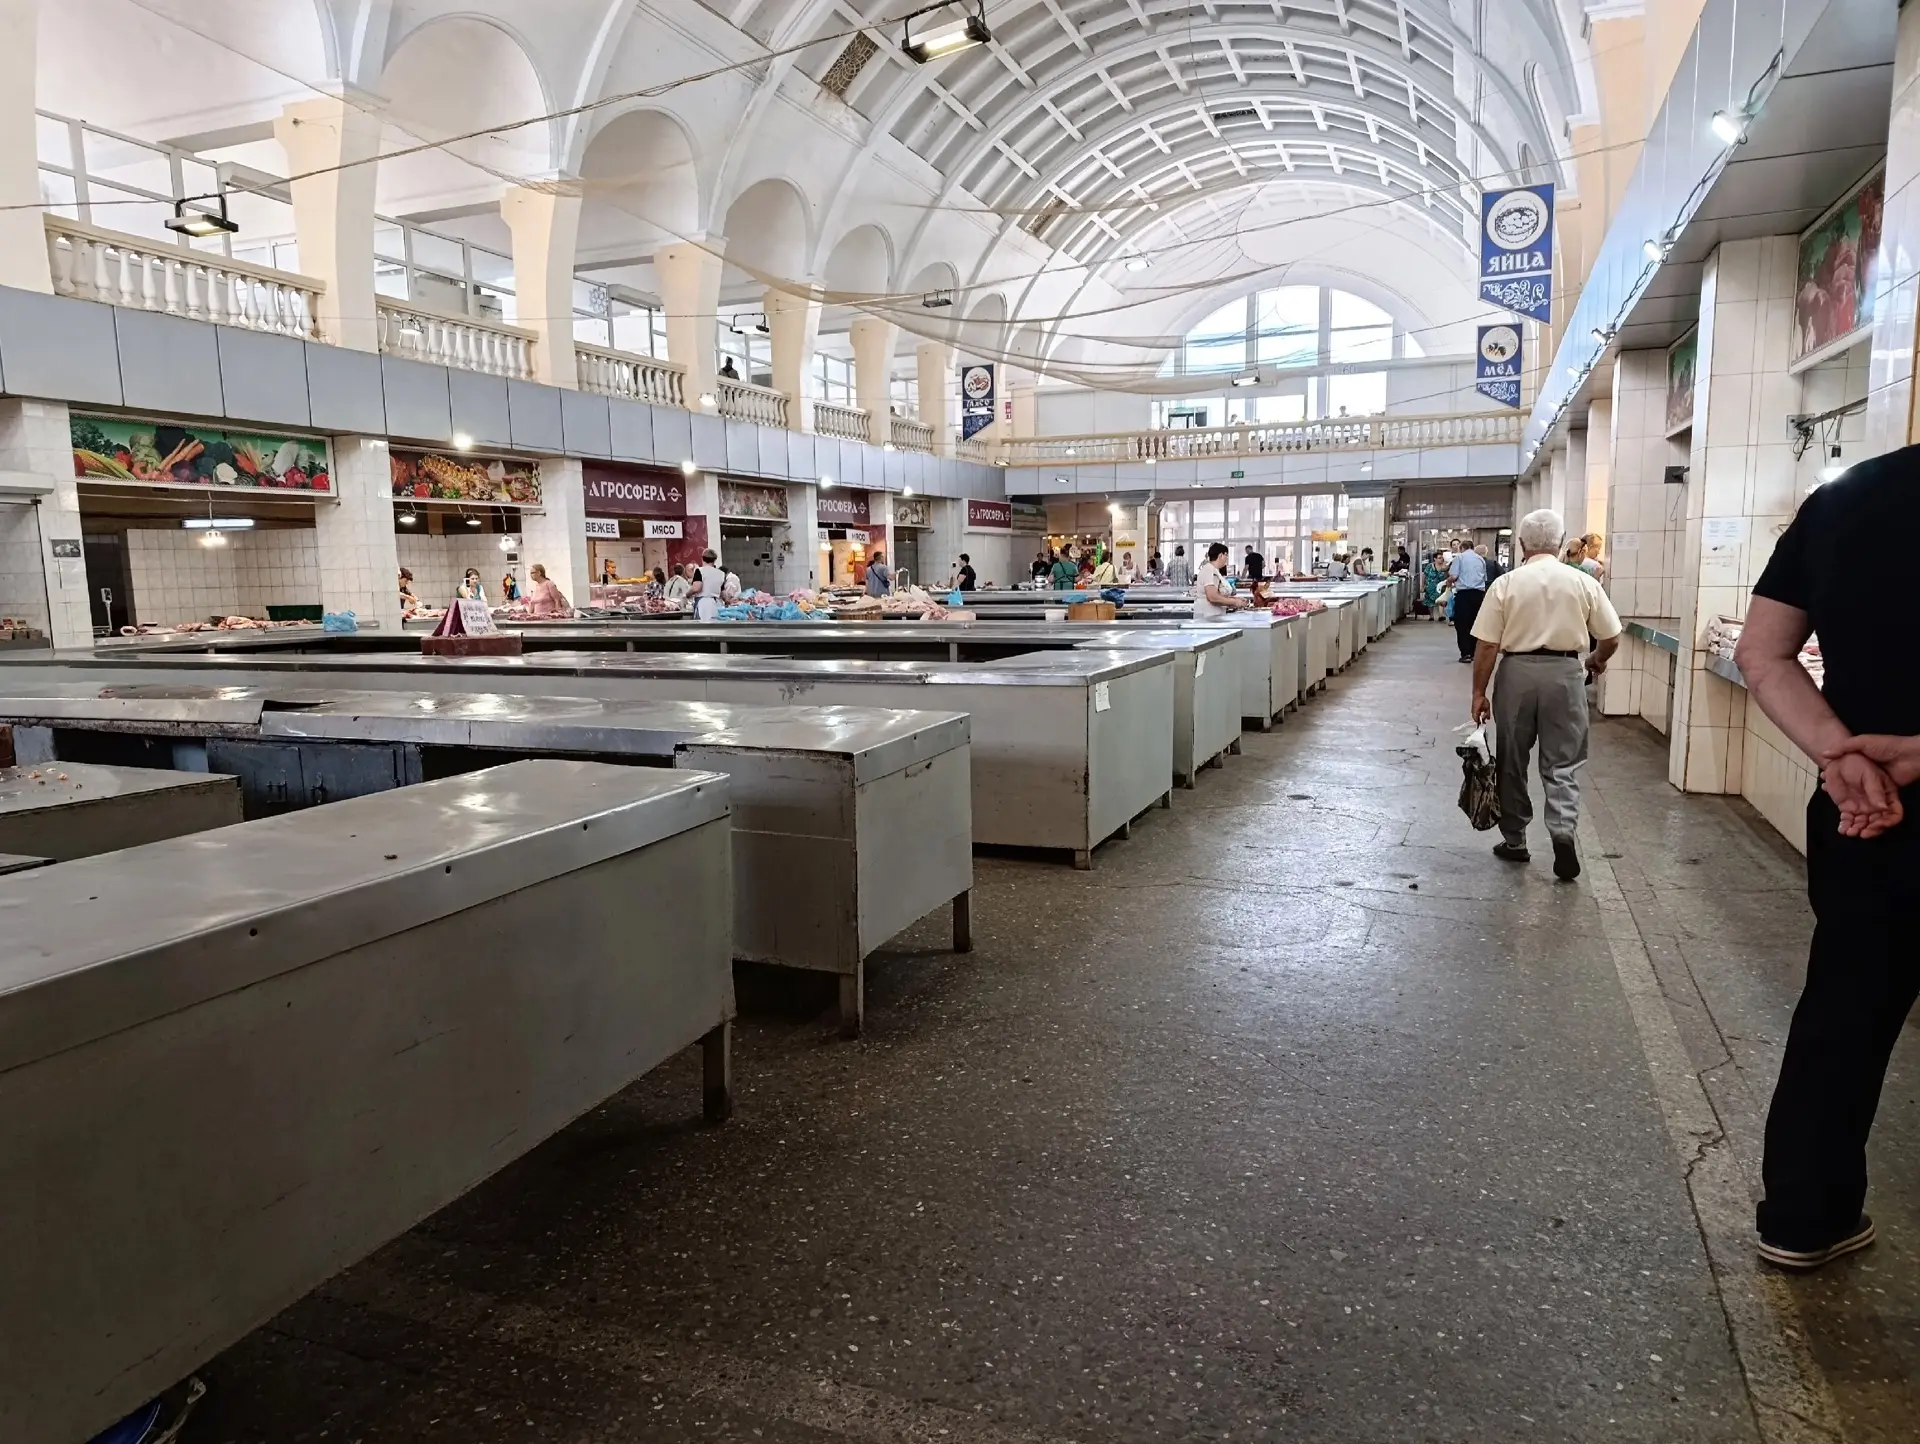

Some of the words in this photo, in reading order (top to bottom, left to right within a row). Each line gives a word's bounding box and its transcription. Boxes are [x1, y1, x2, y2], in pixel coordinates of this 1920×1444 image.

[1487, 251, 1545, 273] ЯЙЦА
[1484, 363, 1515, 376] МЁД
[589, 481, 666, 501] АГРОСФЕРА
[817, 499, 858, 514] ГРОСФЕРА
[585, 522, 616, 534] ВЕЖЕЕ
[652, 525, 675, 535] МЯСО
